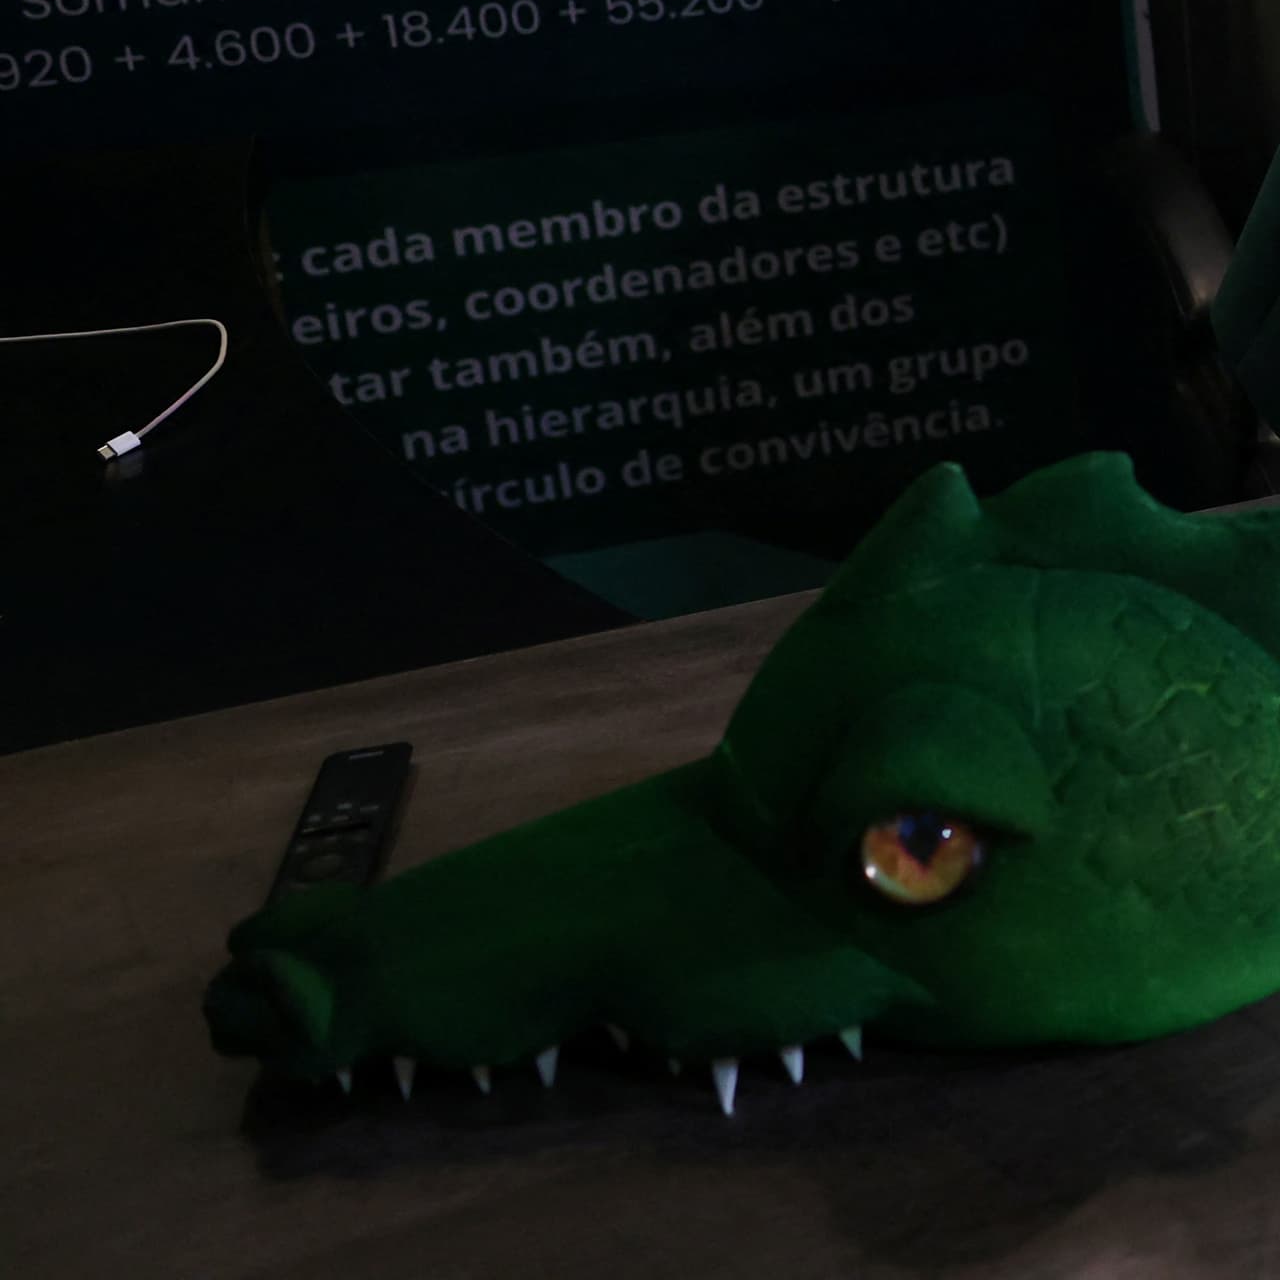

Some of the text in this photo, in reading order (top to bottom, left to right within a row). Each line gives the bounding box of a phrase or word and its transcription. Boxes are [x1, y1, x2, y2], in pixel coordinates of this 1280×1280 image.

[0, 46, 93, 91] 920
[114, 44, 146, 73] +
[168, 23, 316, 71] 4.600
[335, 22, 366, 50] +
[380, 1, 541, 49] 18.400
[560, 0, 588, 26] +
[301, 154, 1016, 276] cada membro da estrutura
[292, 212, 1009, 346] eiros, coordenadores e etc)
[327, 291, 915, 407] tar também, além dos
[401, 336, 1031, 463] na hierarquia, um grupo
[441, 398, 1005, 515] írculo de convivência.
